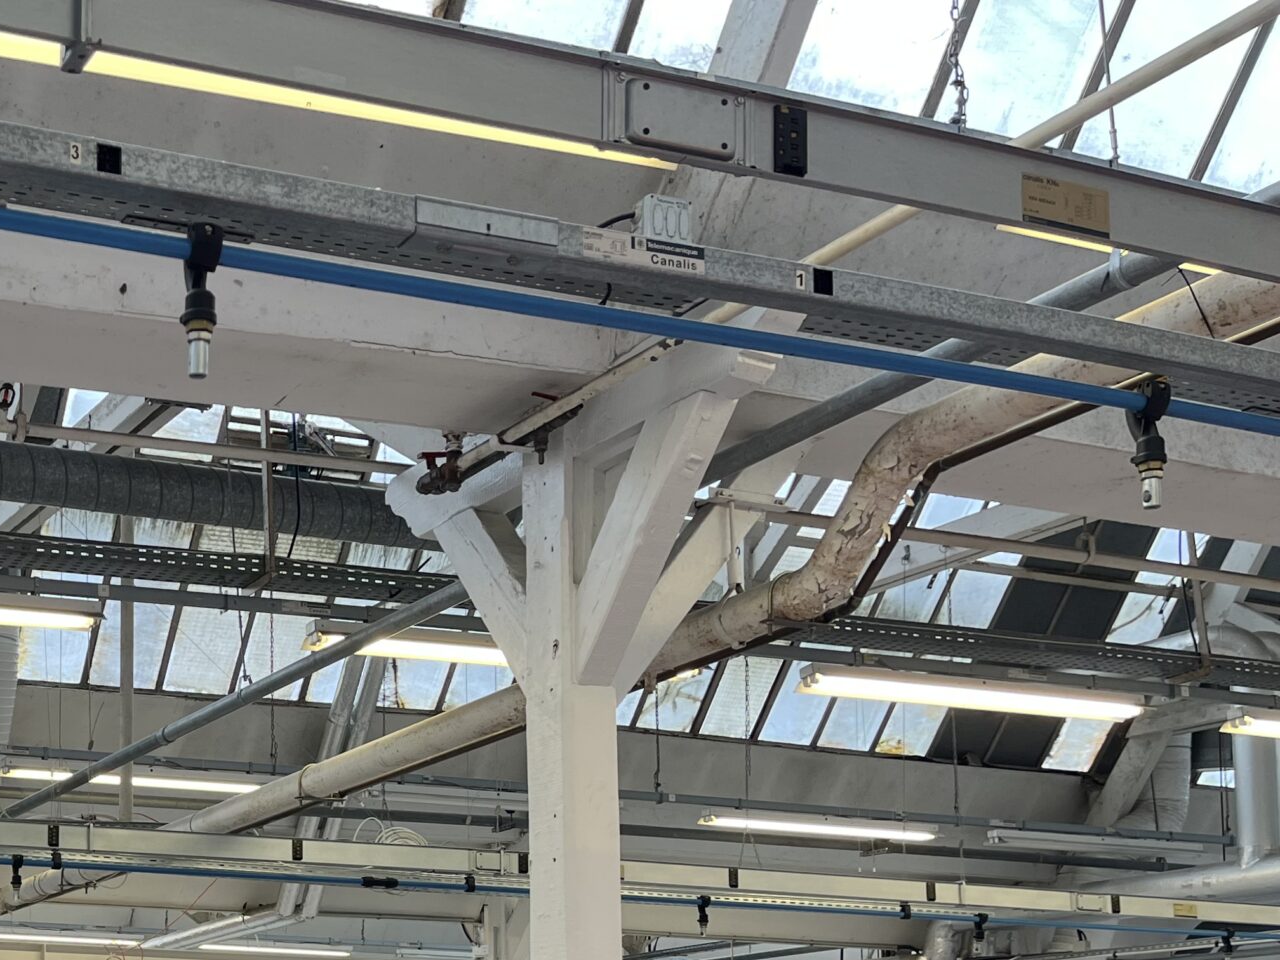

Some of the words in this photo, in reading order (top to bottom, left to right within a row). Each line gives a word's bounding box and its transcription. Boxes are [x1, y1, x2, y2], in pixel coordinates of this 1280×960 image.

[72, 144, 80, 160] 3
[651, 254, 696, 270] Canalis
[796, 273, 804, 287] 1
